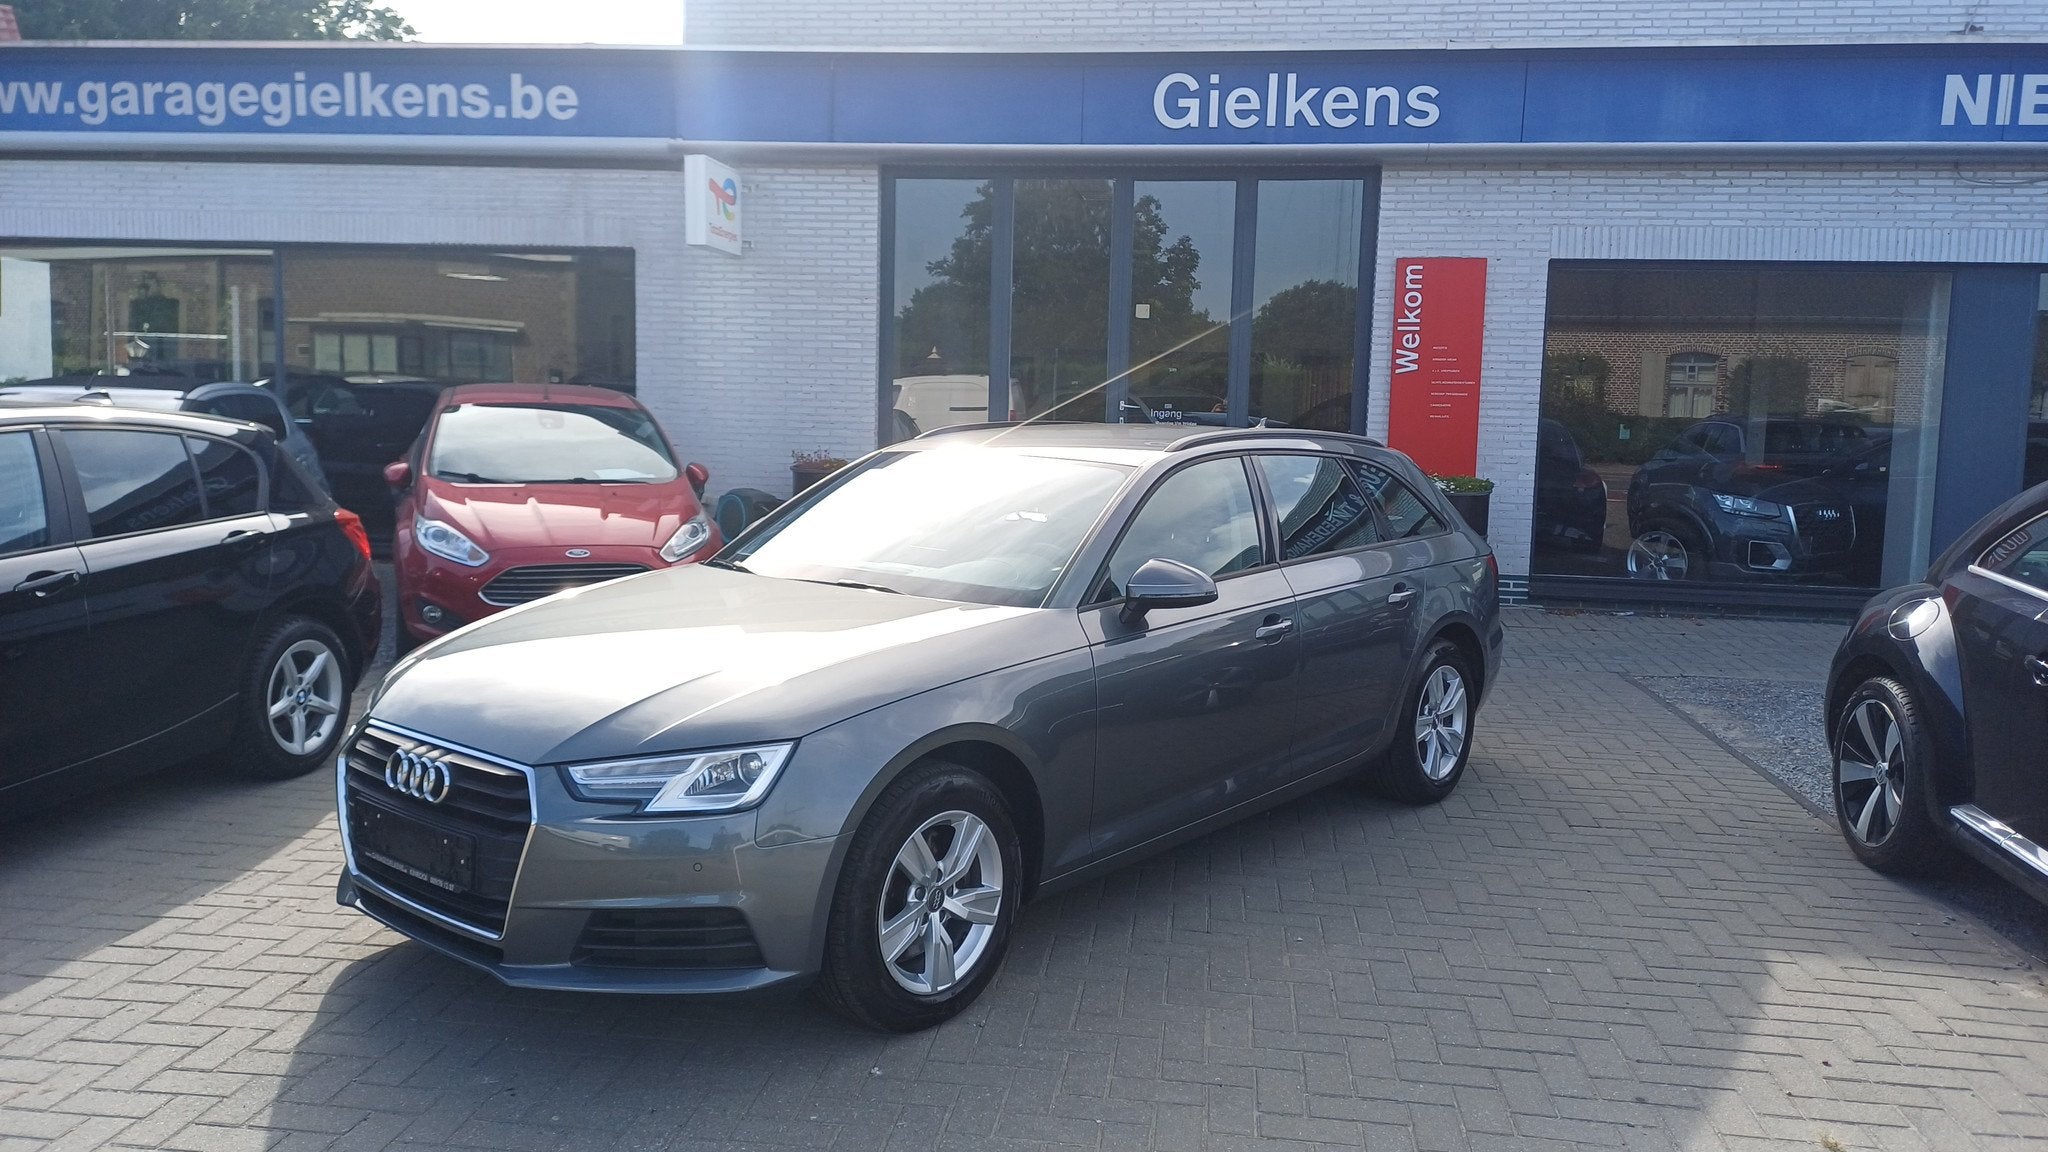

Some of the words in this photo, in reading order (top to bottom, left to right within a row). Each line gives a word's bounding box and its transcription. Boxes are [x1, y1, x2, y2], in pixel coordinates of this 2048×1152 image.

[1153, 73, 1440, 128] Gielkens
[1941, 74, 2048, 125] NIE
[1395, 265, 1424, 374] Welkom
[1150, 408, 1182, 420] Ingang
